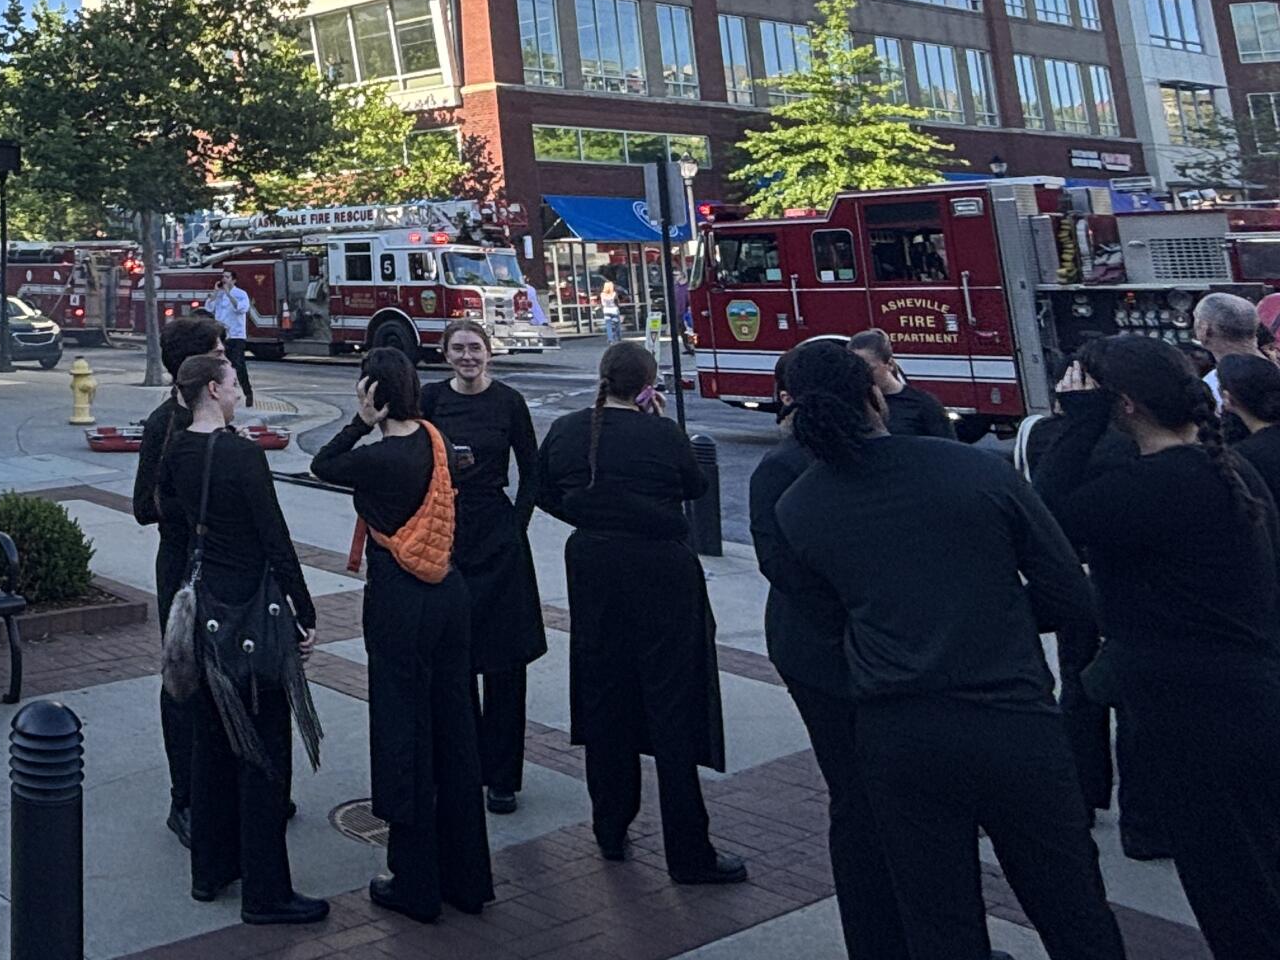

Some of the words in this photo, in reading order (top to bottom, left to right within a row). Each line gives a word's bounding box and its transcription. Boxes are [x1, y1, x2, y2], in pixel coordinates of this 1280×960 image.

[310, 210, 331, 226] FIRE
[334, 208, 374, 224] RESCUE
[383, 260, 393, 274] 5
[881, 298, 950, 313] ASHEVILLE
[899, 315, 936, 328] FIRE
[889, 333, 958, 343] EPARTMENT
